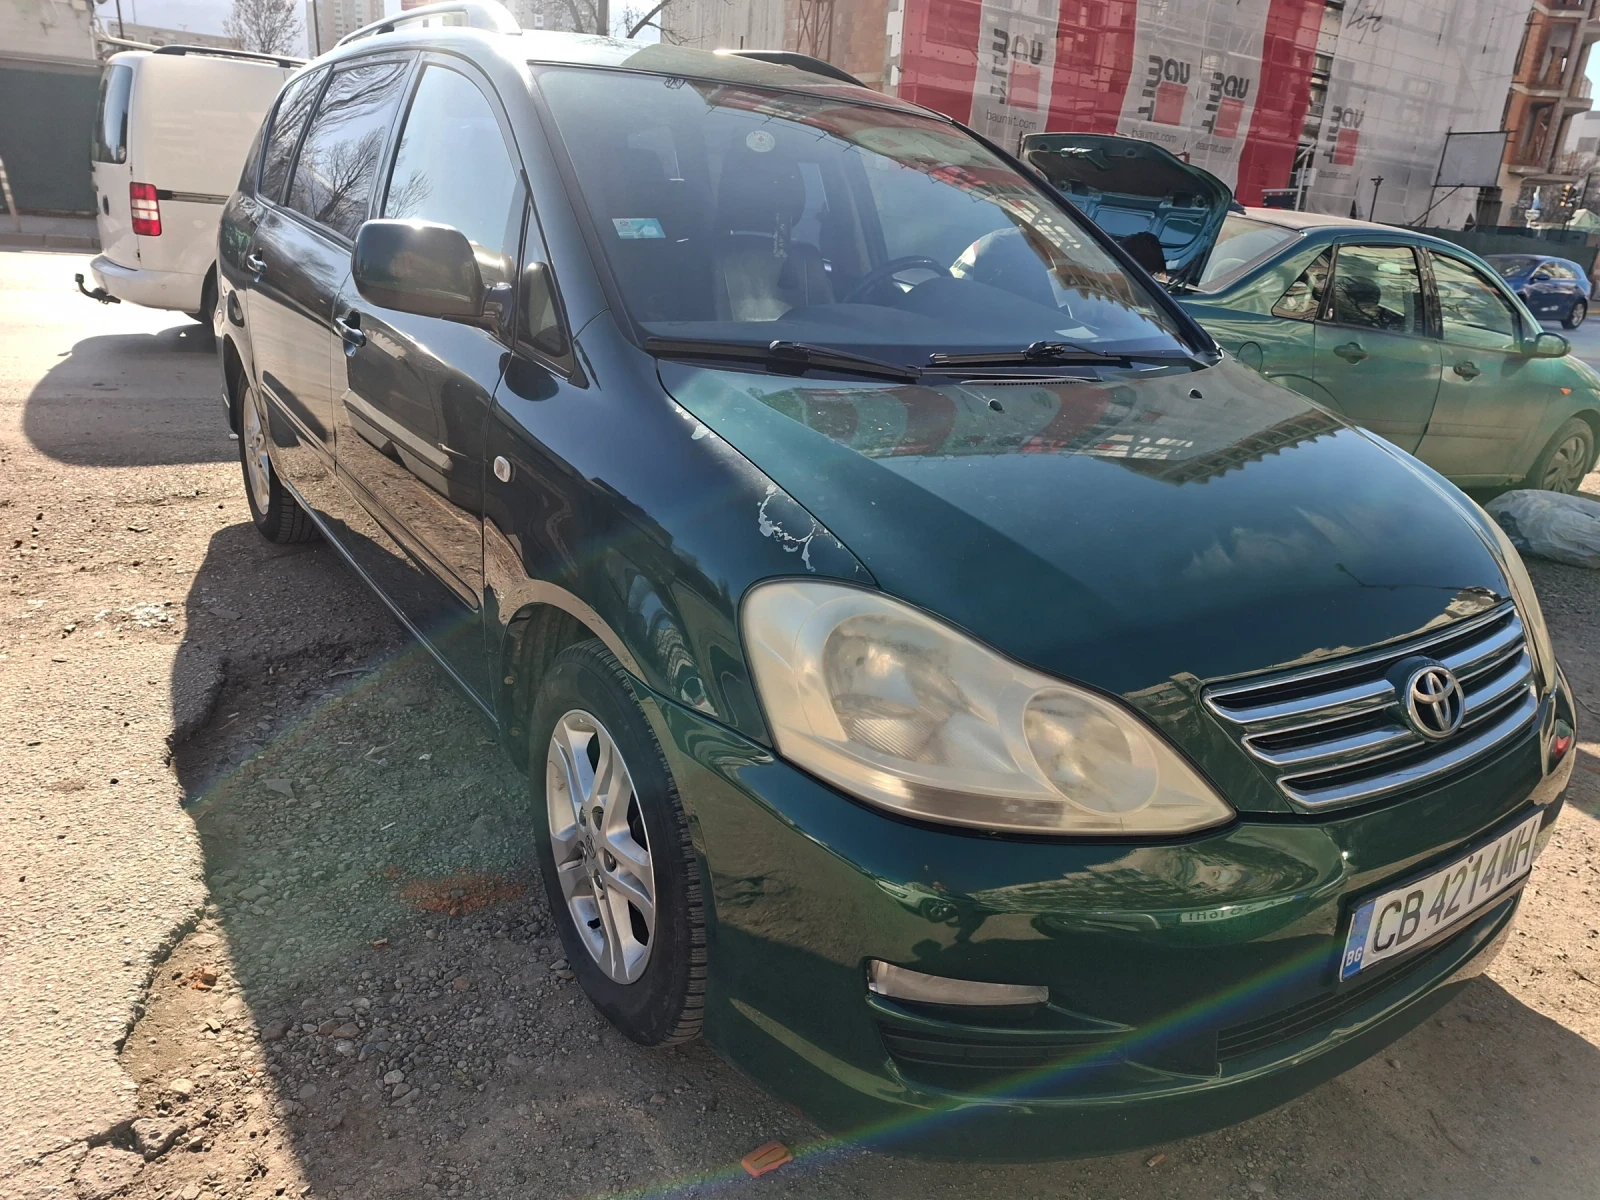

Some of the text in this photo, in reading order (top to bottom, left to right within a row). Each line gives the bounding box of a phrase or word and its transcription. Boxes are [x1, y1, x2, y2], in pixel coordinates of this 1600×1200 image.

[986, 109, 1037, 130] baumit.com
[1131, 128, 1177, 143] baumit.com
[1346, 946, 1363, 967] BG
